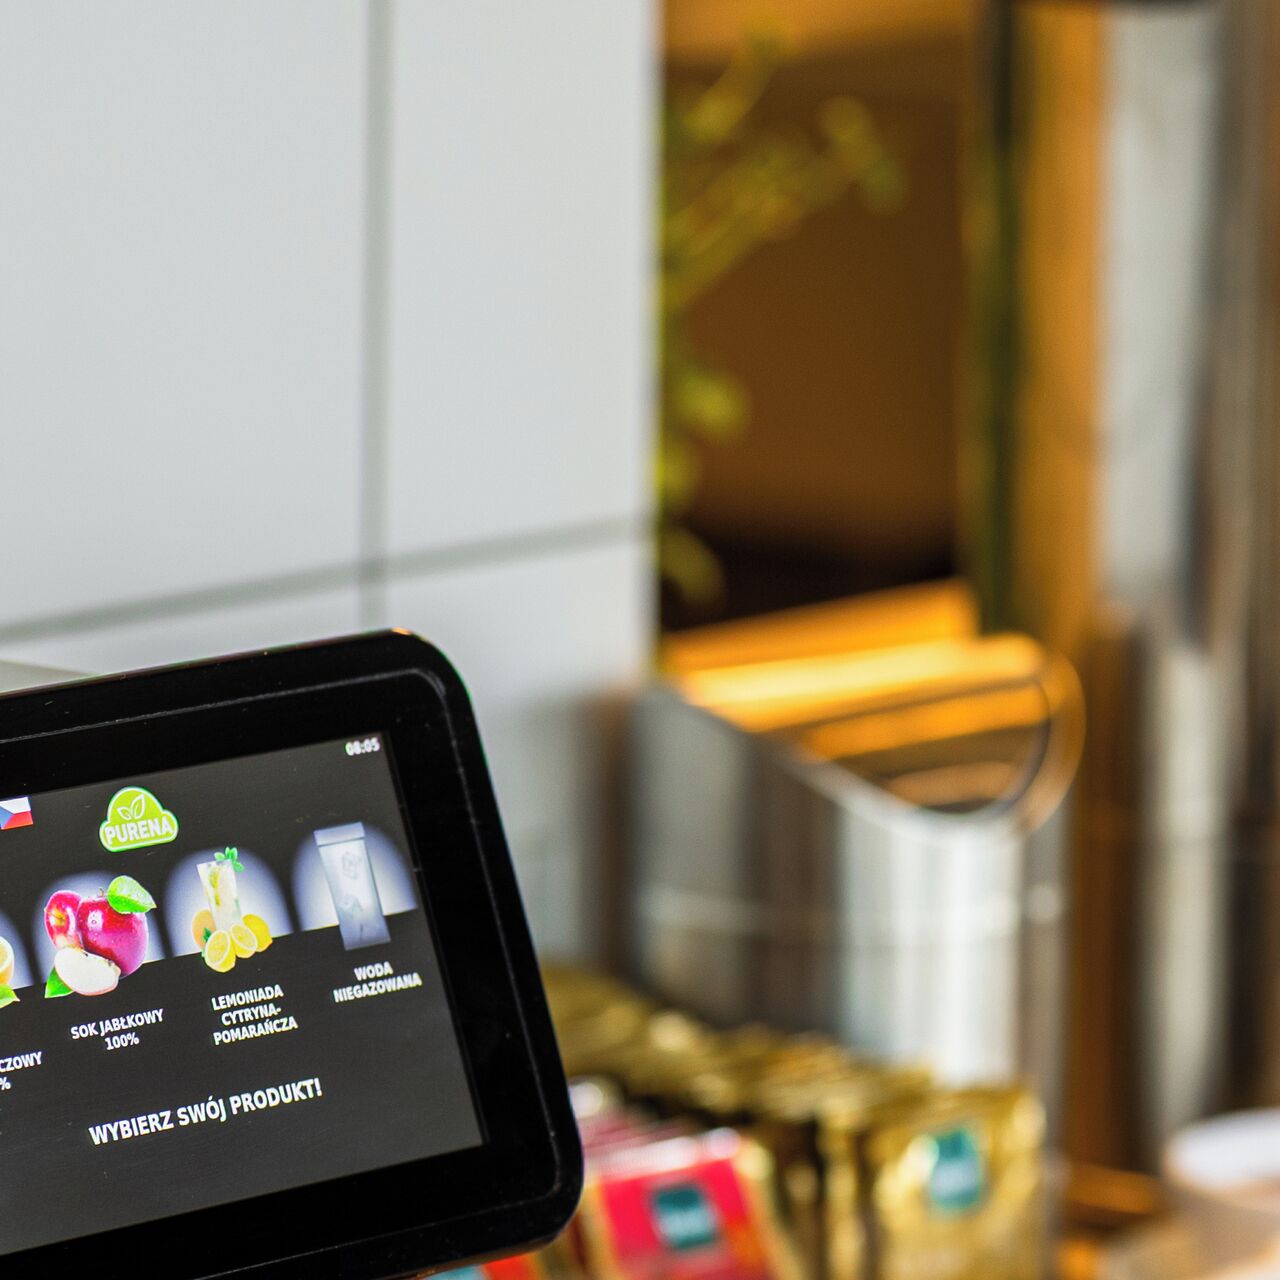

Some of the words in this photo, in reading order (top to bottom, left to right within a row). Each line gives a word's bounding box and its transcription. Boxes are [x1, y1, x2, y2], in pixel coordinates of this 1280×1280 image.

[105, 815, 174, 845] PURENA
[354, 961, 393, 981] WODA
[211, 984, 284, 1011] LEMONIADA
[333, 972, 423, 1003] NIEGAZOWANA
[70, 1022, 99, 1040] SOK
[100, 1008, 164, 1036] JABŁKOWY
[221, 1003, 282, 1026] CYTRYNA-
[105, 1032, 140, 1050] 100%
[213, 1016, 299, 1046] POMARAŃCZA
[88, 1110, 174, 1146] WYBIERZ
[177, 1095, 227, 1122] SWÓJ
[229, 1077, 322, 1115] PRODUKT!
